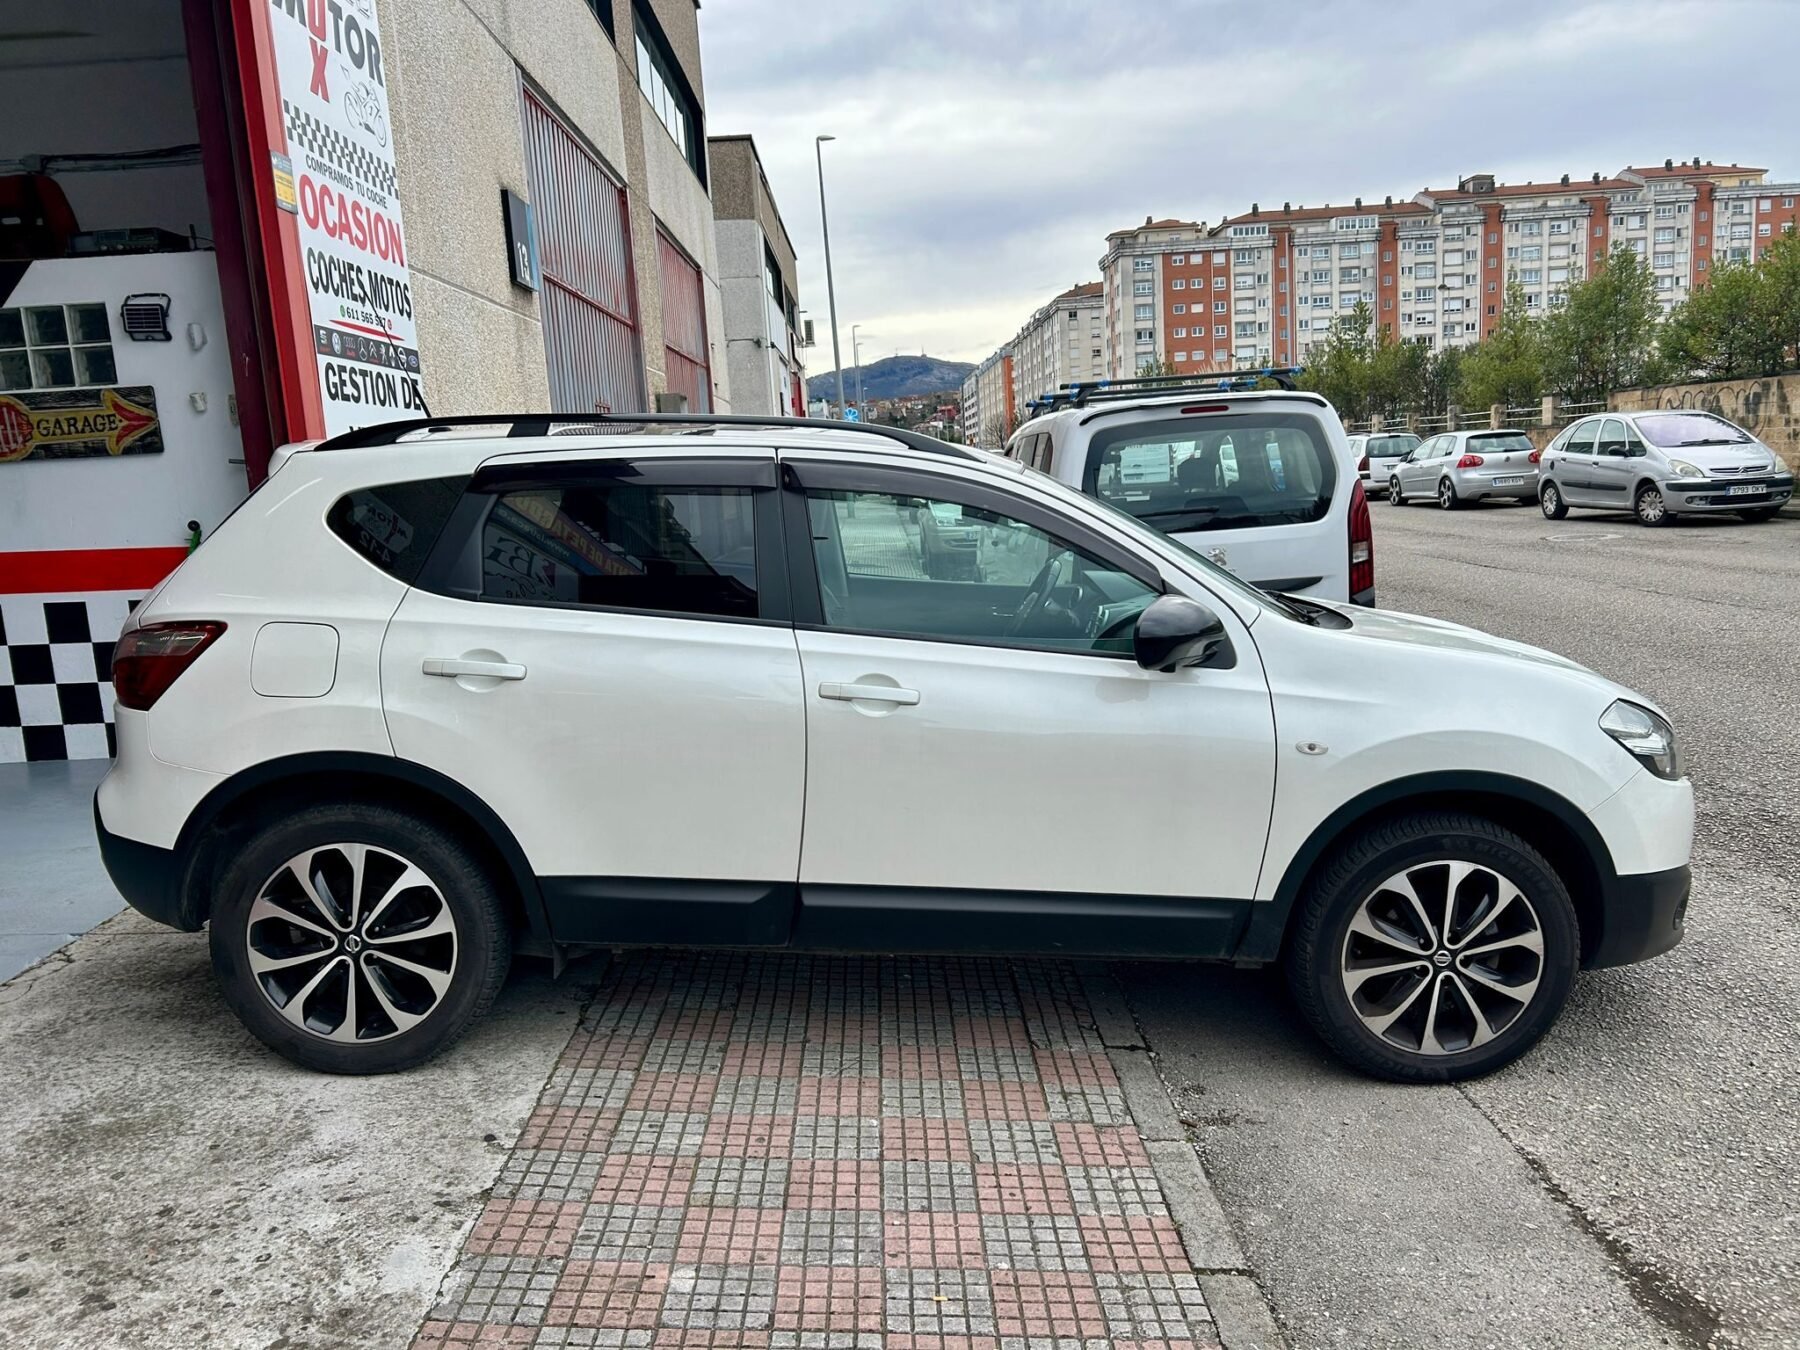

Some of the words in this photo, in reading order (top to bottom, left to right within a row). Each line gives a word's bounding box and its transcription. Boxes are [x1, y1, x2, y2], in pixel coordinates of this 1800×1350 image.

[306, 154, 354, 191] COMPRAMOS
[356, 181, 366, 197] TU
[366, 188, 388, 210] COCHE
[299, 174, 404, 268] OCASION
[346, 306, 360, 321] 611
[361, 311, 374, 325] 565
[325, 362, 399, 409] GESTION
[401, 377, 422, 411] DE
[36, 413, 119, 437] GARAGE
